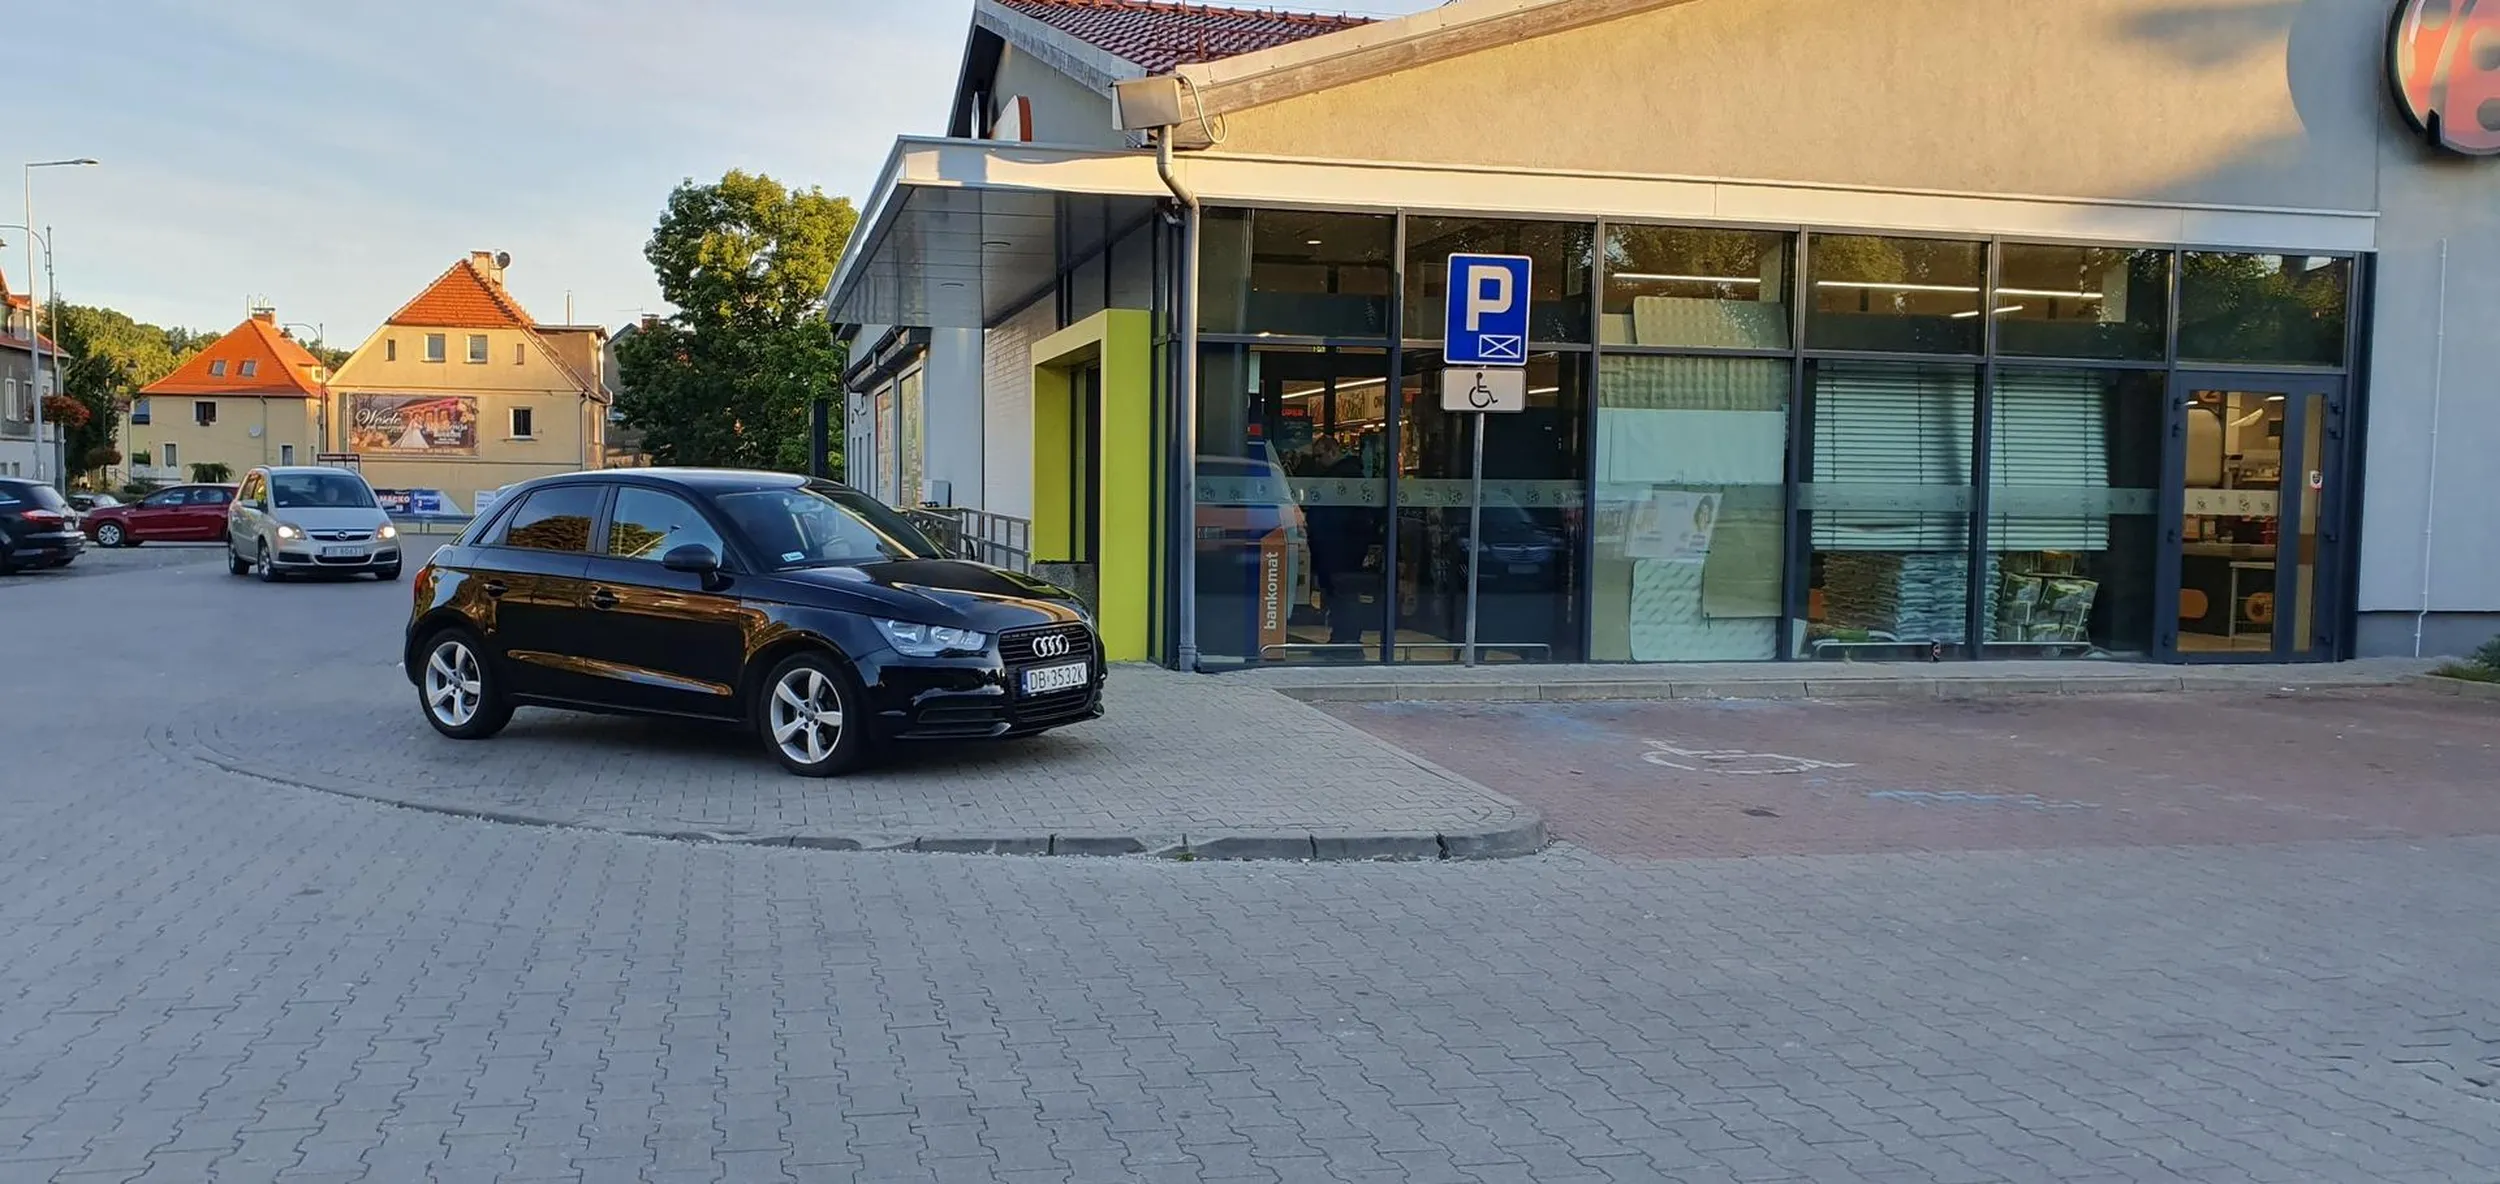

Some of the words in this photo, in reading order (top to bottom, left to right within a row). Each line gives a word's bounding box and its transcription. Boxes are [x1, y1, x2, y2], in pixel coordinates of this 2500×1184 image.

[1466, 265, 1513, 331] P
[1264, 551, 1279, 630] bankomat
[1030, 671, 1046, 689] DB
[1050, 664, 1084, 687] 3532K
